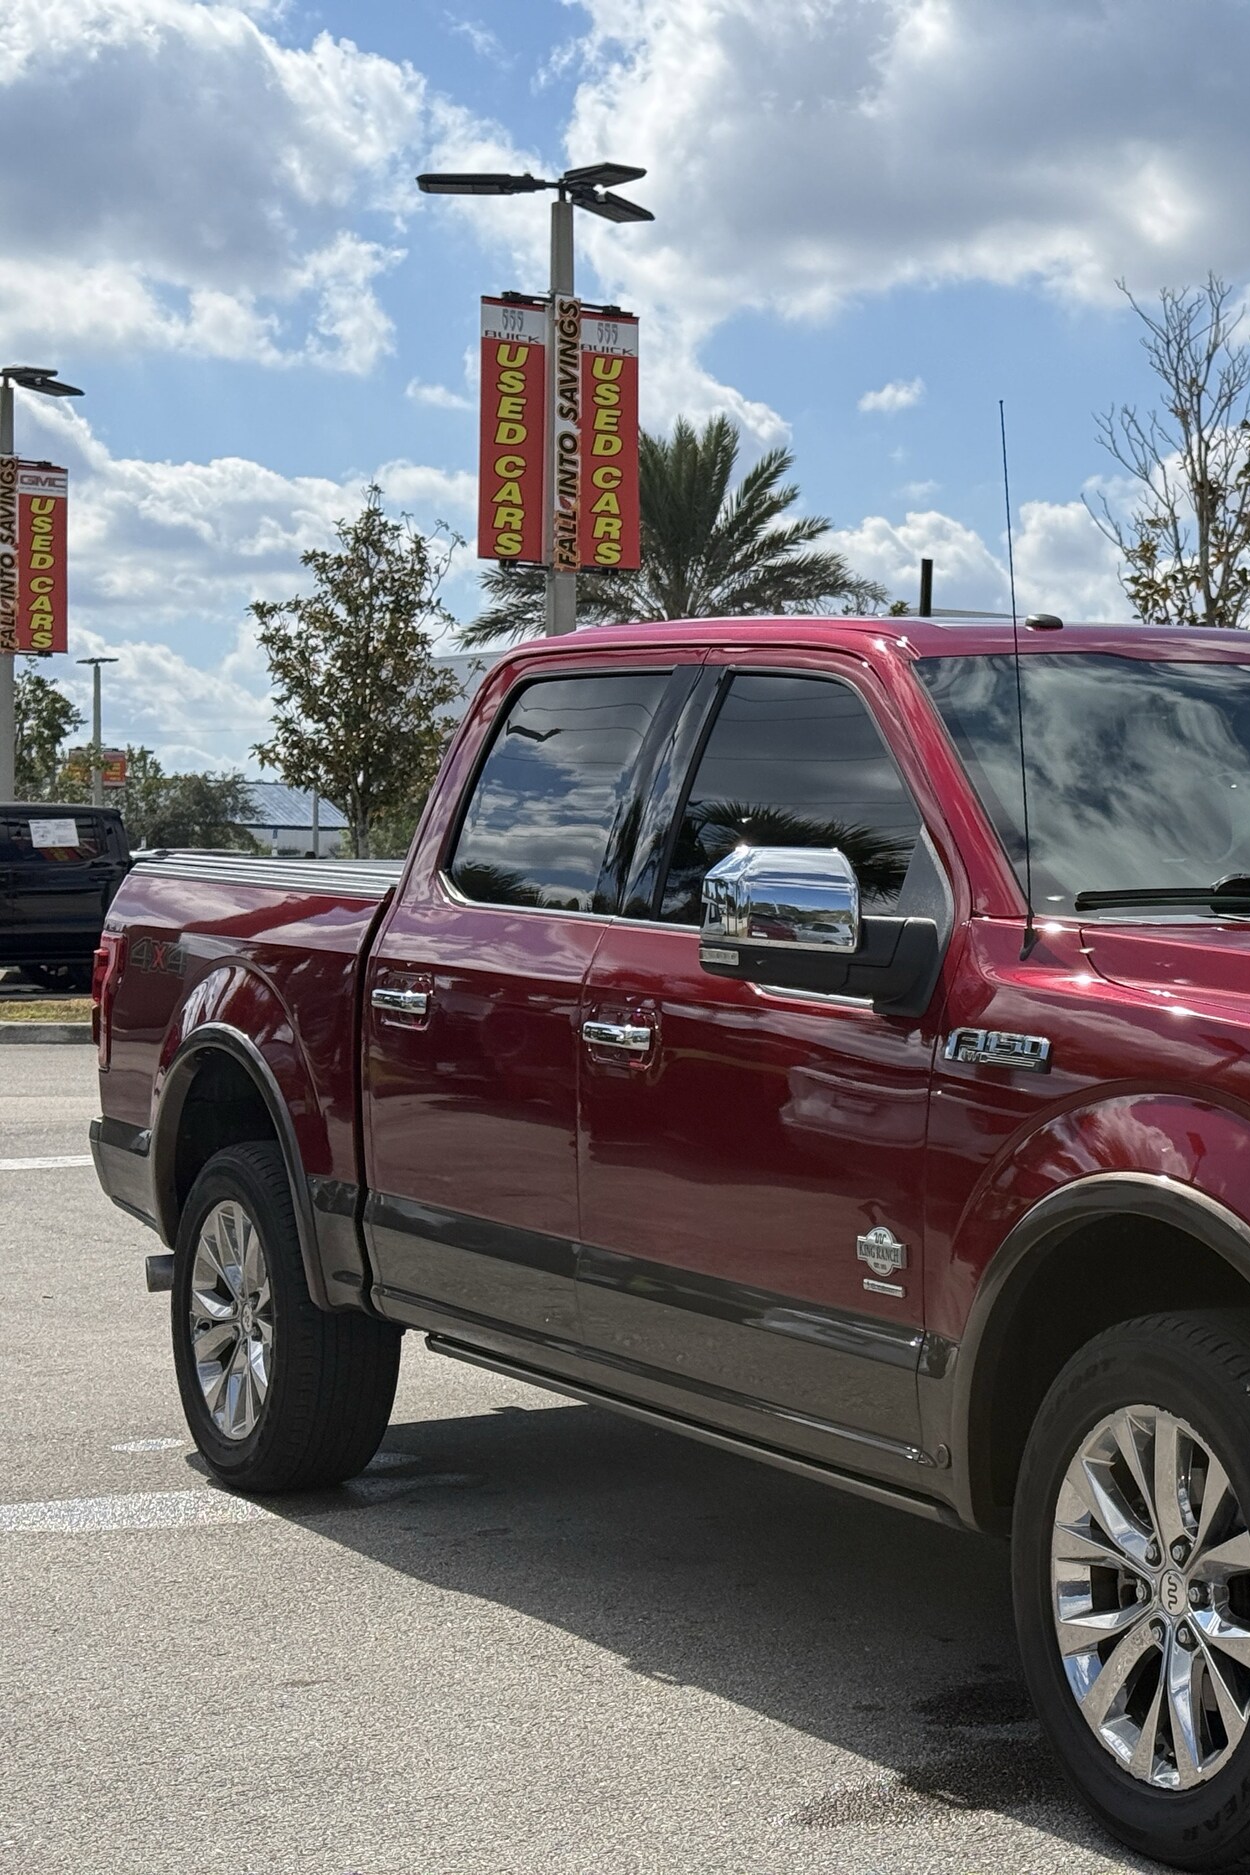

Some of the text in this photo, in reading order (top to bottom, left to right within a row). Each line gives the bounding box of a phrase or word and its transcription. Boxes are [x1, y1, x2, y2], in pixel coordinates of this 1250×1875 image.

[491, 344, 529, 556] USED CARS
[558, 299, 580, 567] FALL INTO SAVINGS
[591, 357, 624, 566] USED CARS
[0, 459, 17, 545] SAVINGS
[20, 475, 66, 488] GMC
[30, 497, 56, 571] USED
[0, 552, 16, 604] INTO
[28, 576, 54, 649] CARS
